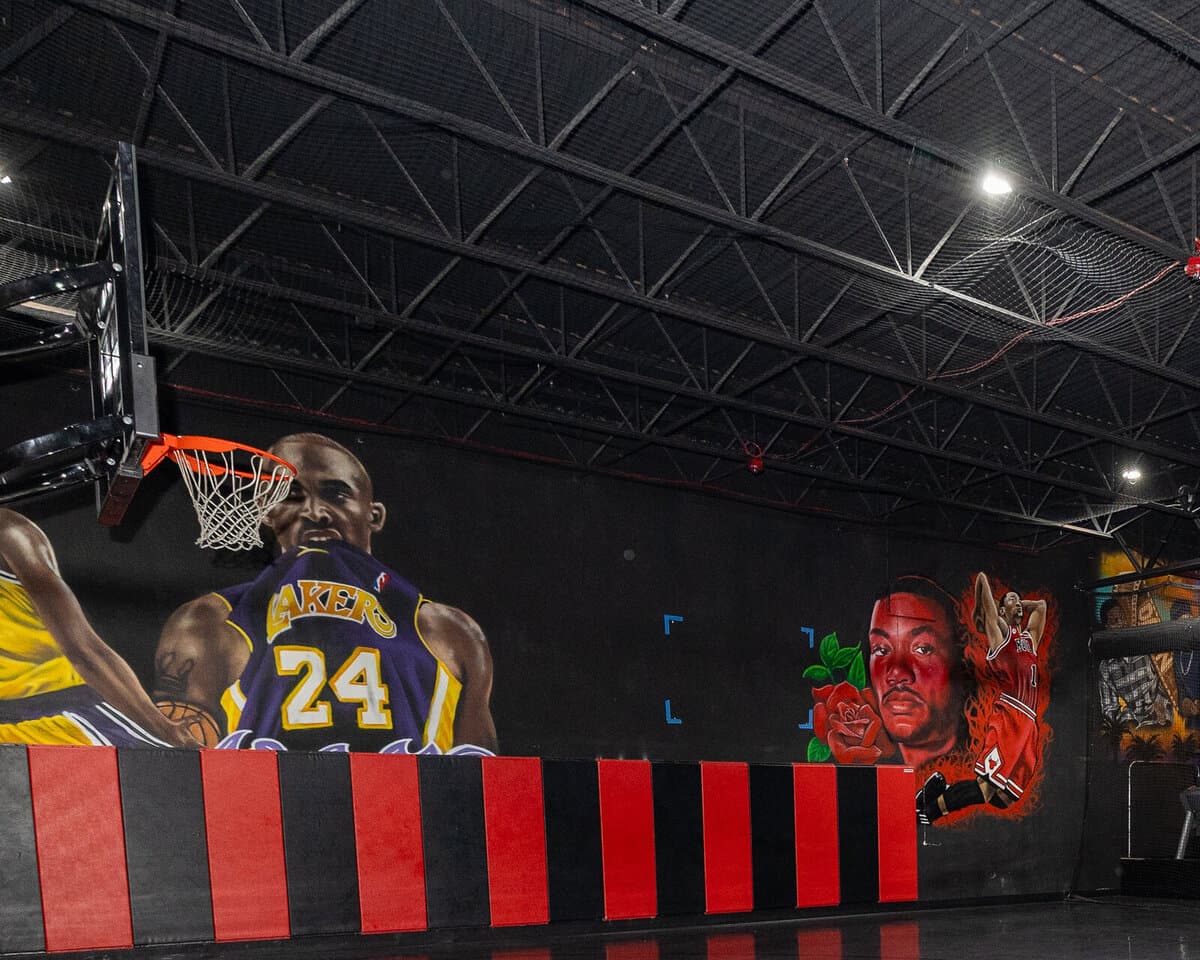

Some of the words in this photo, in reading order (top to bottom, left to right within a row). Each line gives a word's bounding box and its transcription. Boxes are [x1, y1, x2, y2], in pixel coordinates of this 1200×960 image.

[266, 580, 397, 644] LAKERS
[273, 645, 393, 731] 24
[1031, 664, 1037, 687] 1
